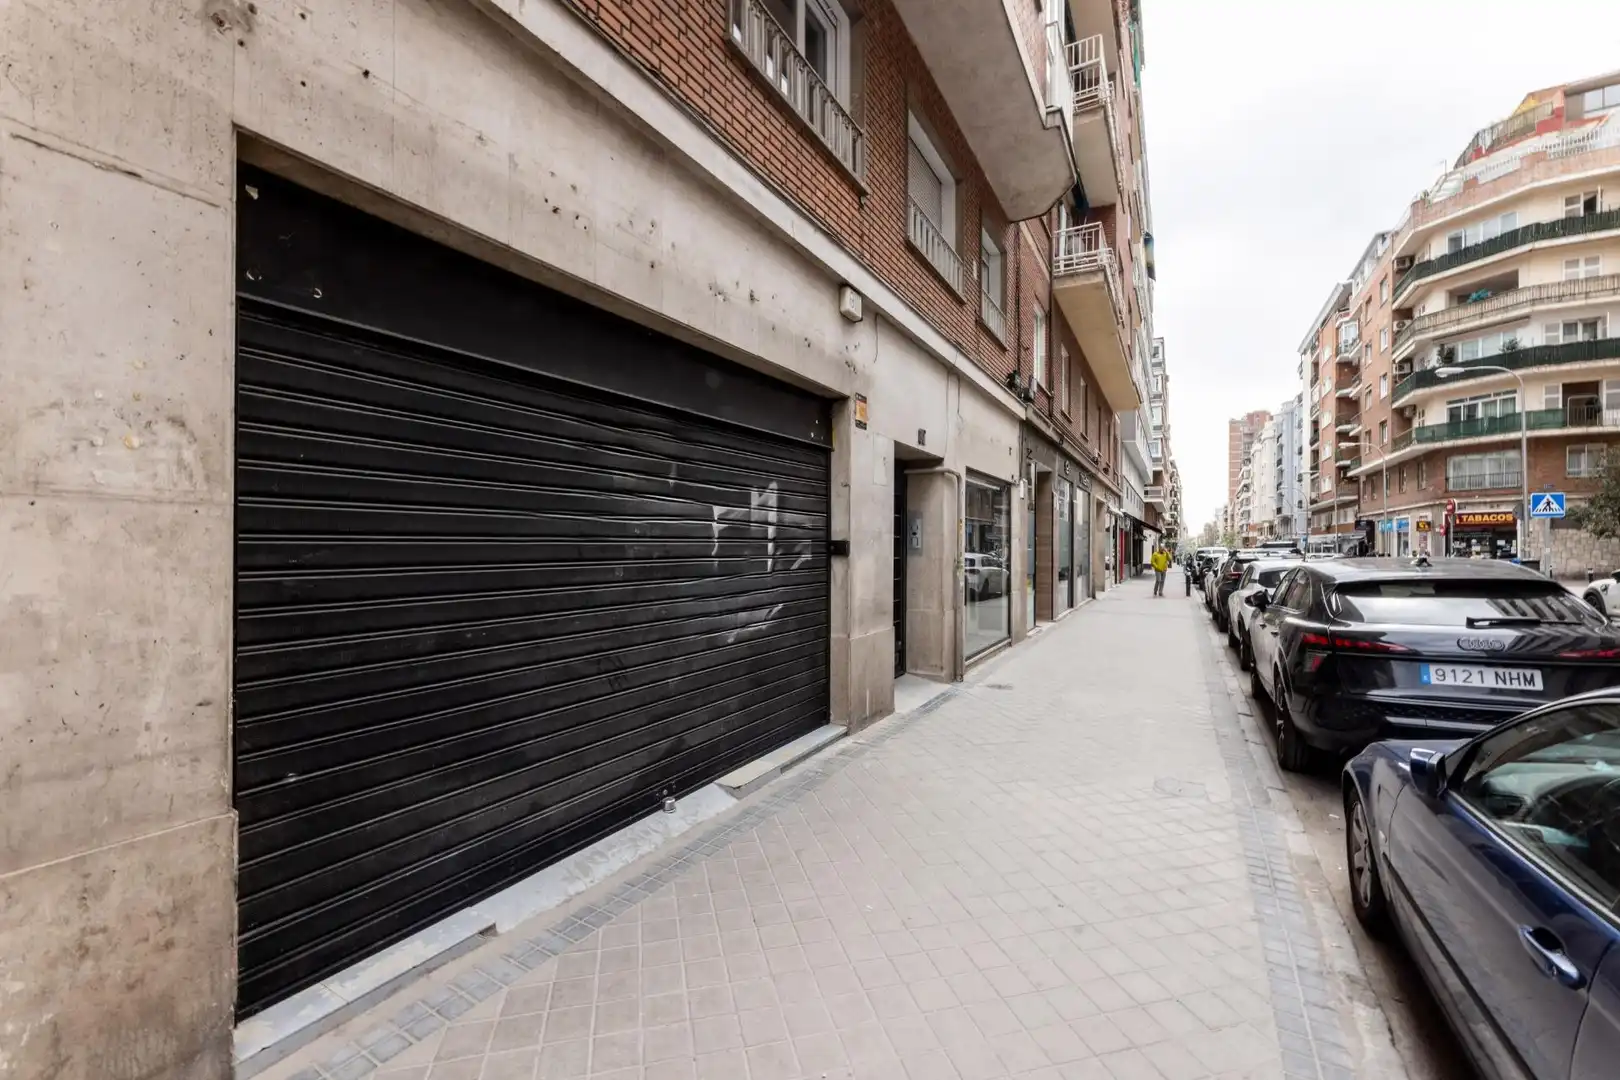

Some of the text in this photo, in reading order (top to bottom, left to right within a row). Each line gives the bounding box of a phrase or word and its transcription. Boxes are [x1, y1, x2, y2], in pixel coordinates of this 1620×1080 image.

[1461, 513, 1514, 523] TABACOS
[1435, 668, 1536, 688] 9121 NHM
